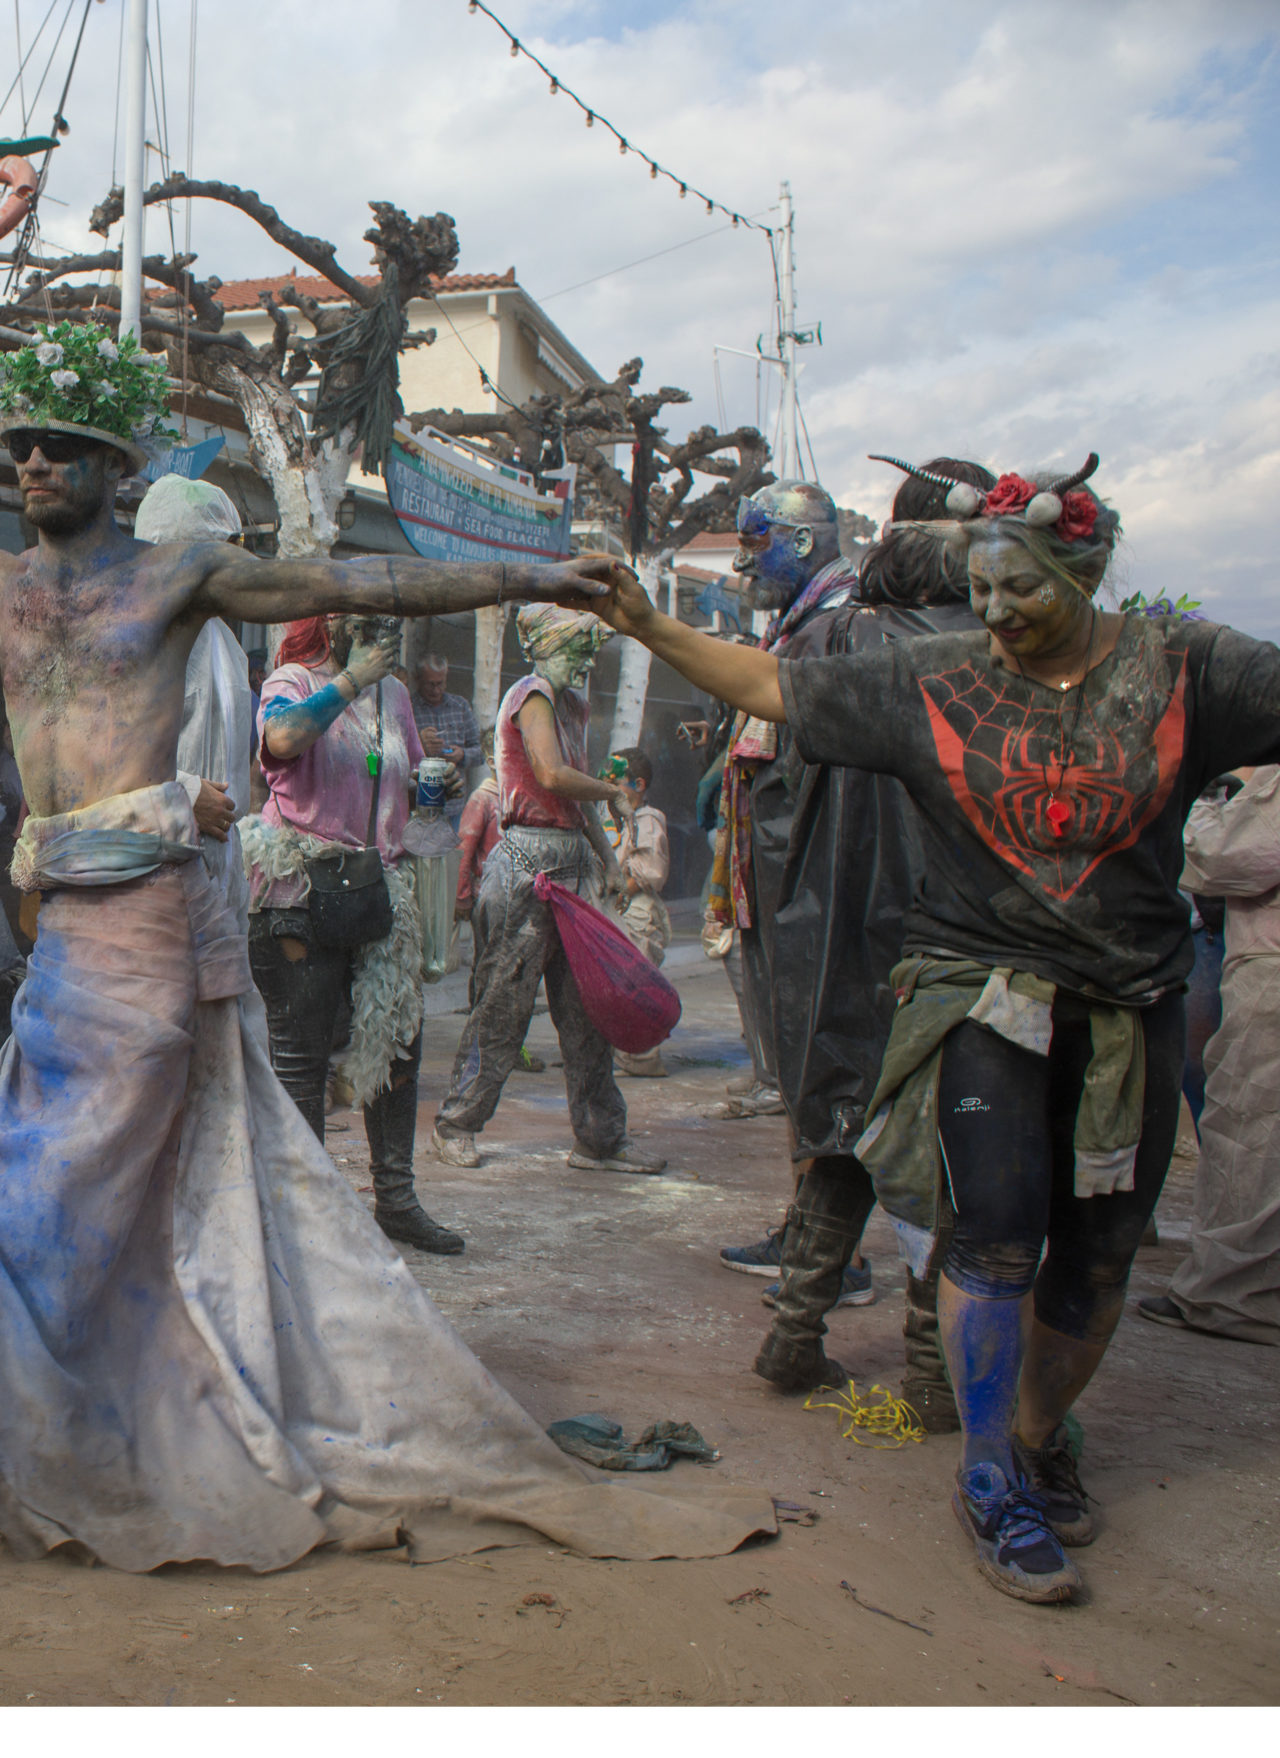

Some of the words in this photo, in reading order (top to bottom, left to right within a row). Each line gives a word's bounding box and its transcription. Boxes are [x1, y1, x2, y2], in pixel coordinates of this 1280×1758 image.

[401, 487, 455, 526] RESTAURANT
[464, 516, 481, 536] SEA
[484, 523, 504, 541] FOOD
[414, 525, 448, 551] WELCOME
